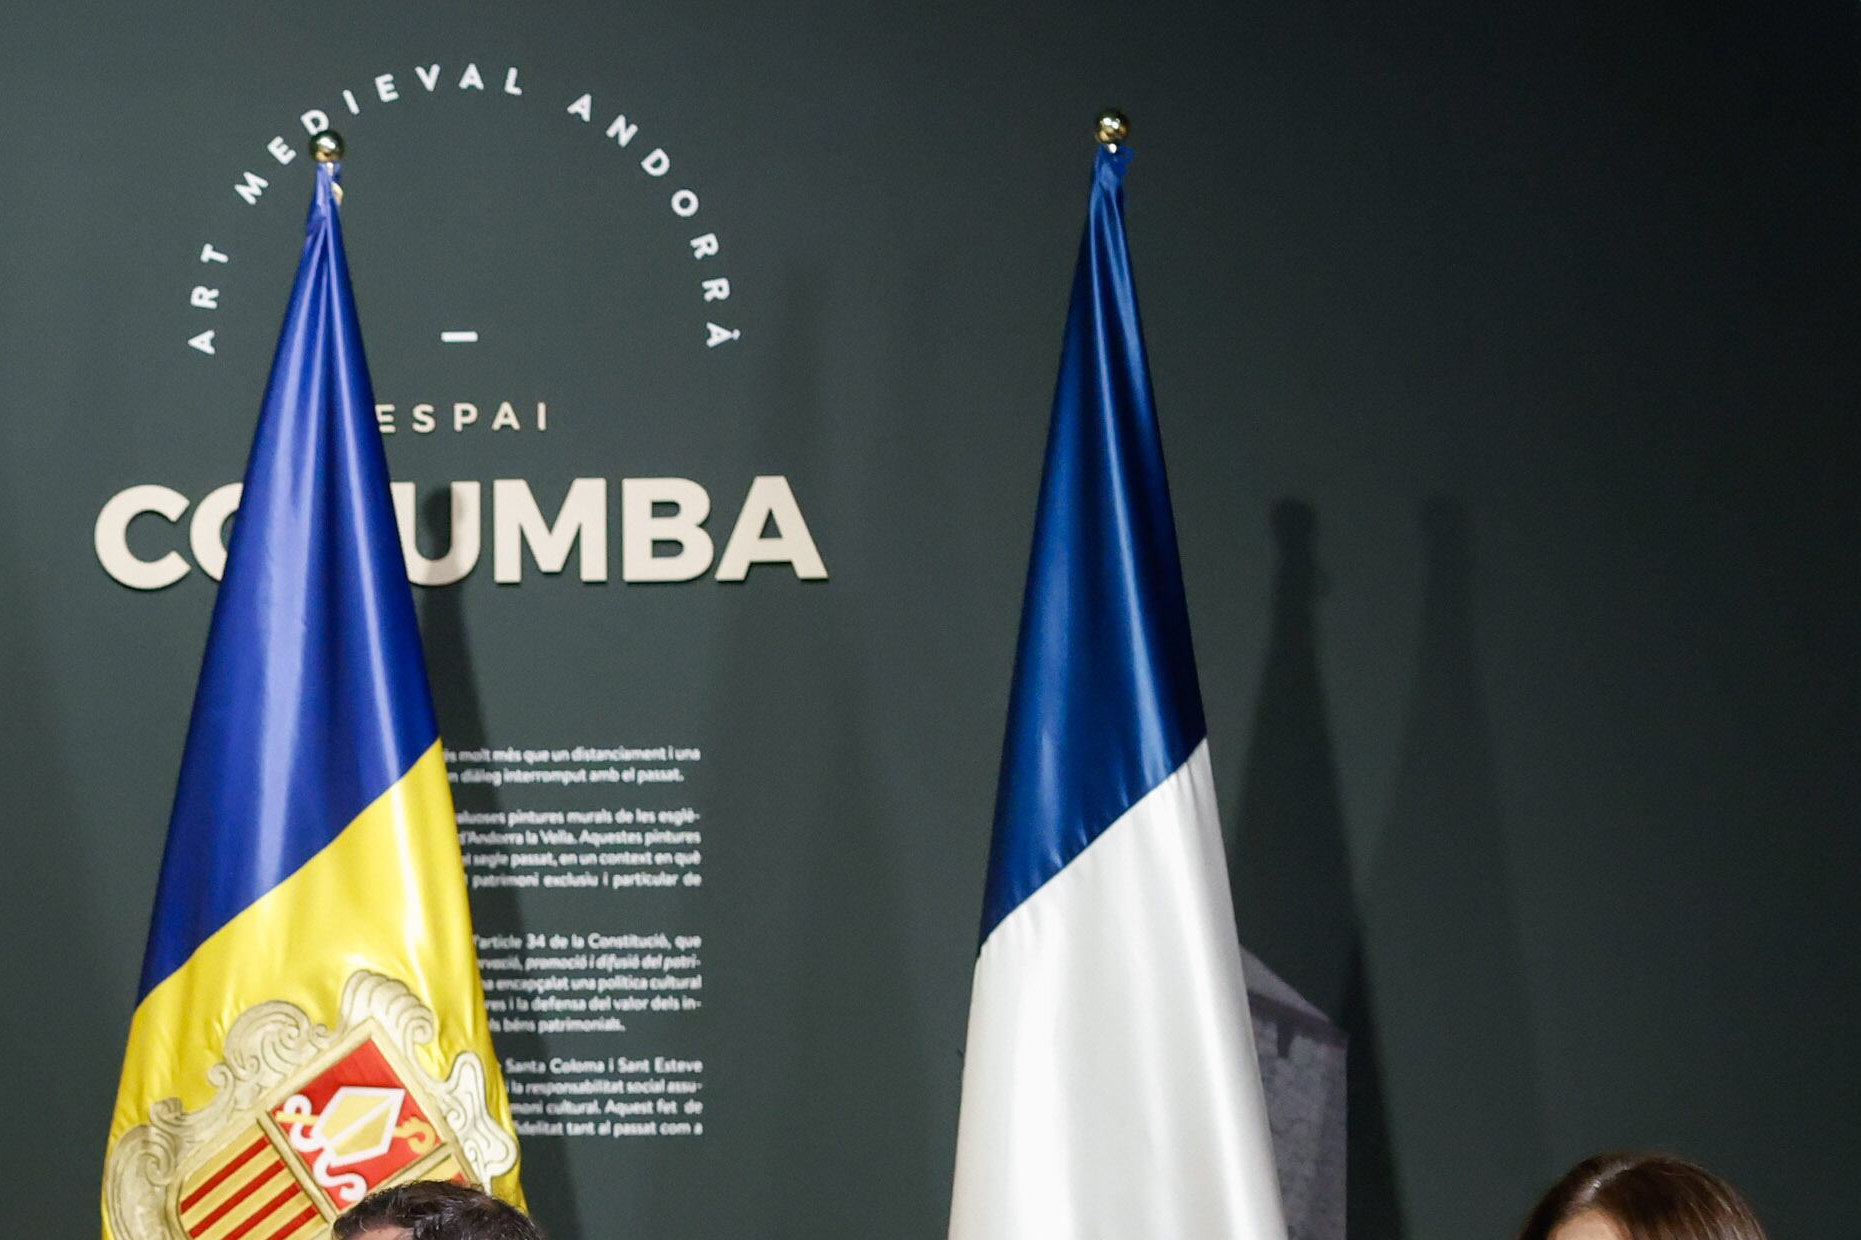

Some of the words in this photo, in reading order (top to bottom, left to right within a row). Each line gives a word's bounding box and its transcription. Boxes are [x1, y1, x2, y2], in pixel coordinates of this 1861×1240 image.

[187, 243, 230, 356] ART
[234, 63, 524, 206] MEDIEVAL
[566, 93, 742, 349] ANDORRÀ
[374, 402, 547, 433] ESPAI
[93, 475, 830, 590] CUMBA
[523, 749, 550, 765] que
[551, 749, 570, 762] un
[525, 830, 538, 845] la
[579, 854, 598, 867] un
[571, 934, 585, 950] la
[674, 937, 702, 953] que
[641, 955, 662, 971] del
[516, 997, 529, 1012] la
[588, 997, 612, 1012] del
[511, 1079, 524, 1095] la
